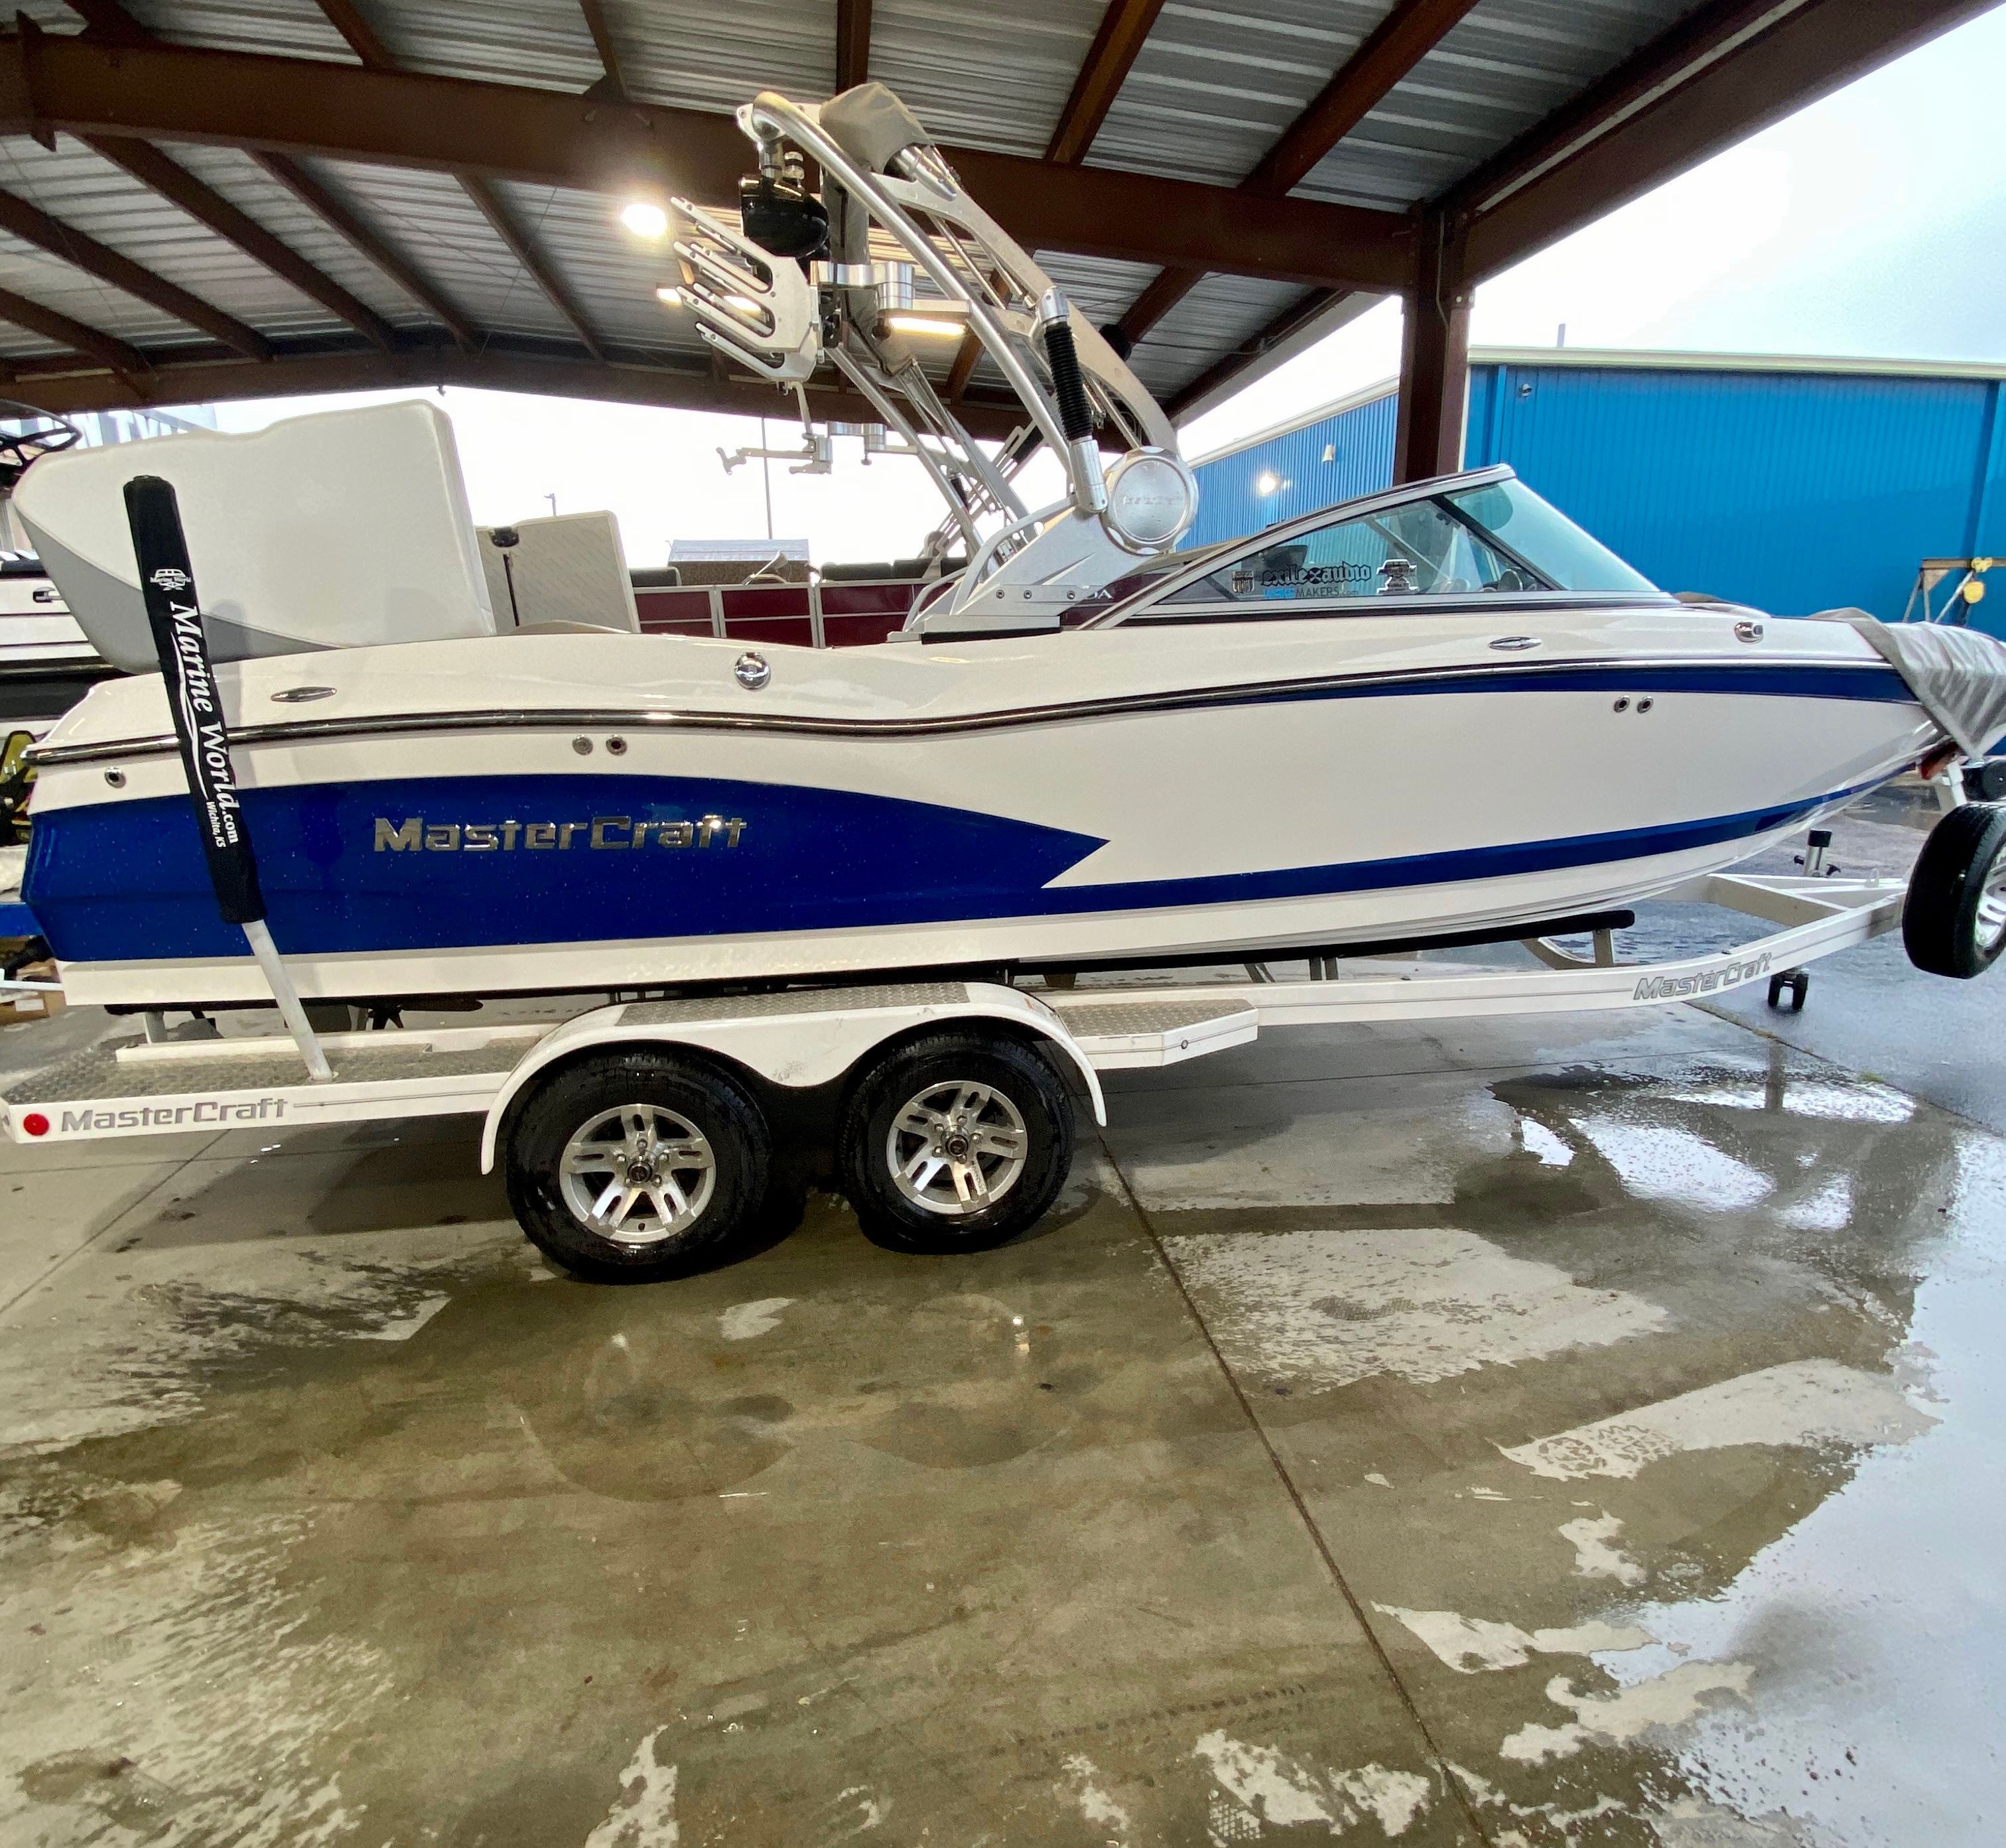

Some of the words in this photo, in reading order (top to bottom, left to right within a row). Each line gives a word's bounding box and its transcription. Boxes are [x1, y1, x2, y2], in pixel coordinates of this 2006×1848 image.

[170, 601, 213, 712] Marine
[200, 721, 240, 844] World.com
[373, 815, 747, 852] MasterCraft
[1633, 952, 1772, 1000] MasterCraft
[62, 1098, 288, 1132] MasterCraft
